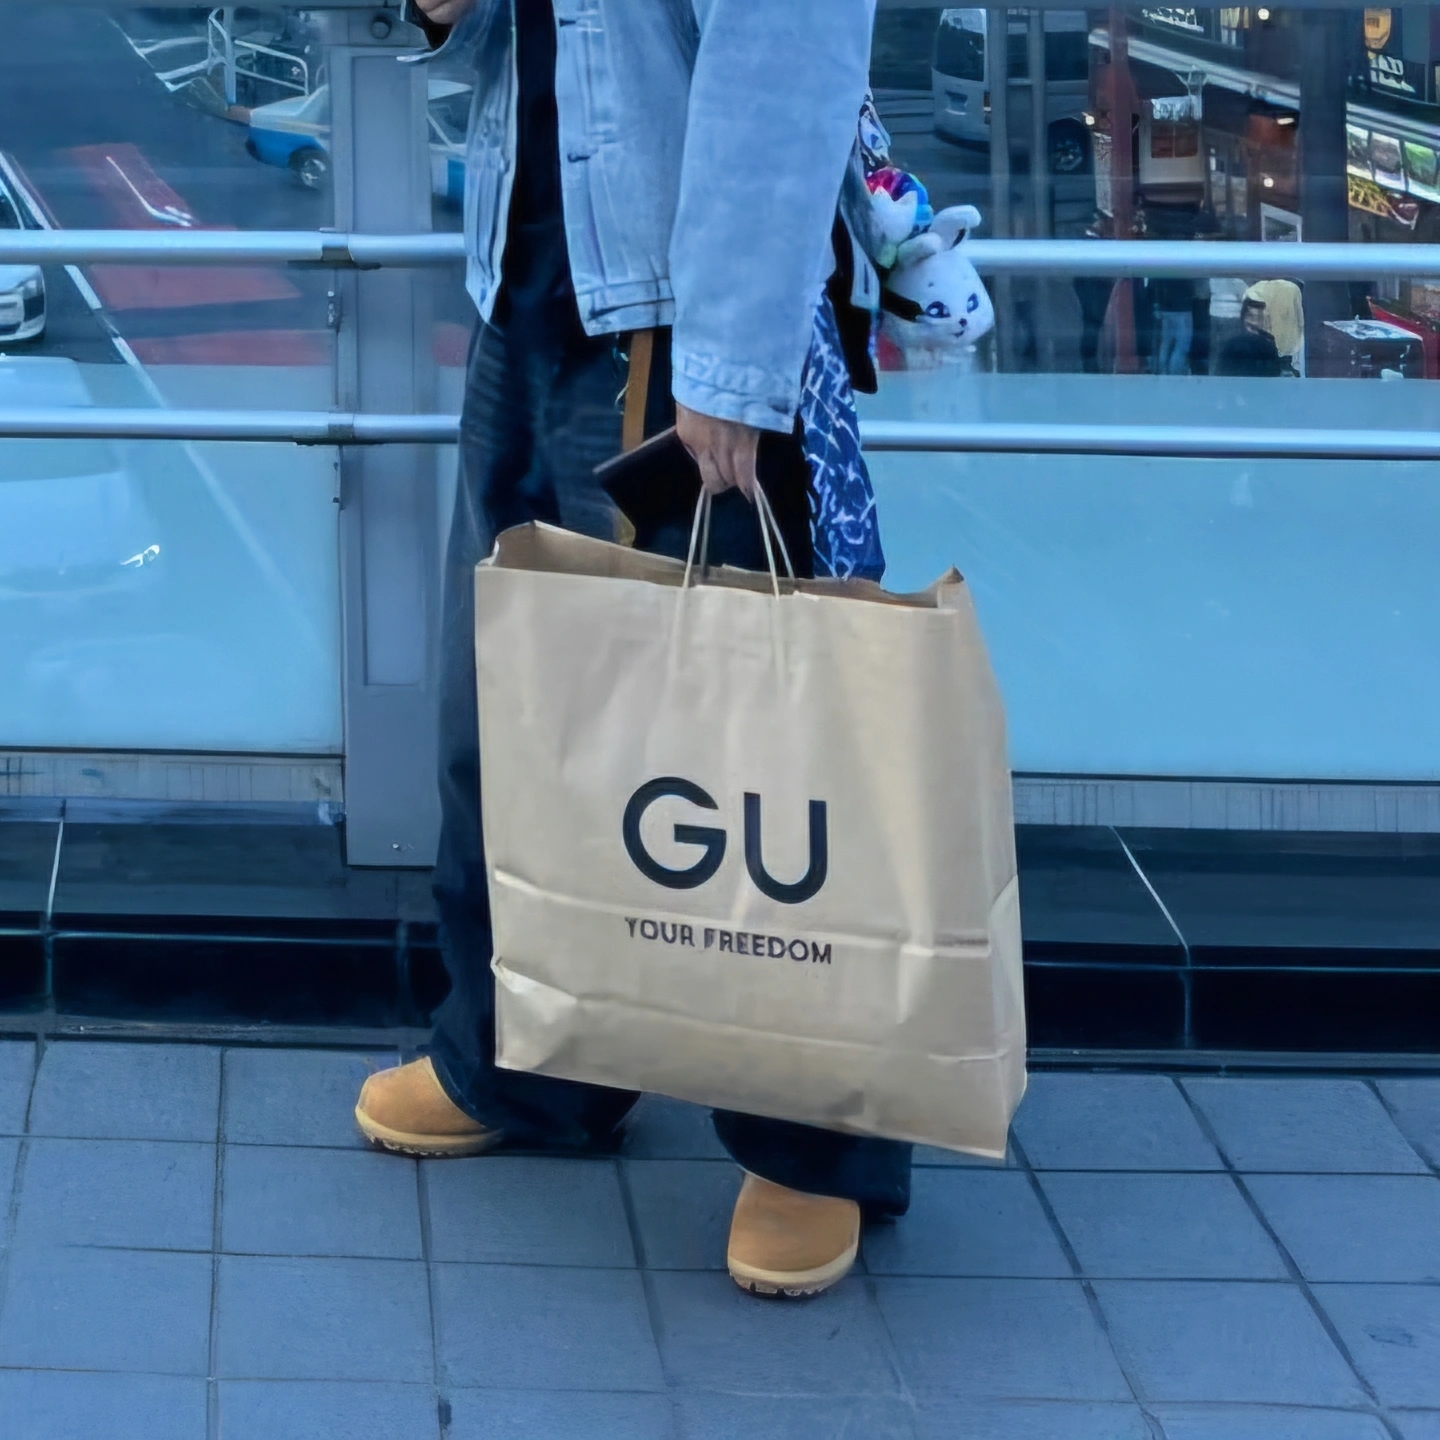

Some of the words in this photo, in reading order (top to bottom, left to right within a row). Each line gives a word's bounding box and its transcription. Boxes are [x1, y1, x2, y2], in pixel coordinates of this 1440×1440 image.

[622, 776, 829, 904] GU
[624, 916, 695, 947] YOUR
[703, 927, 832, 965] FREEDOM
